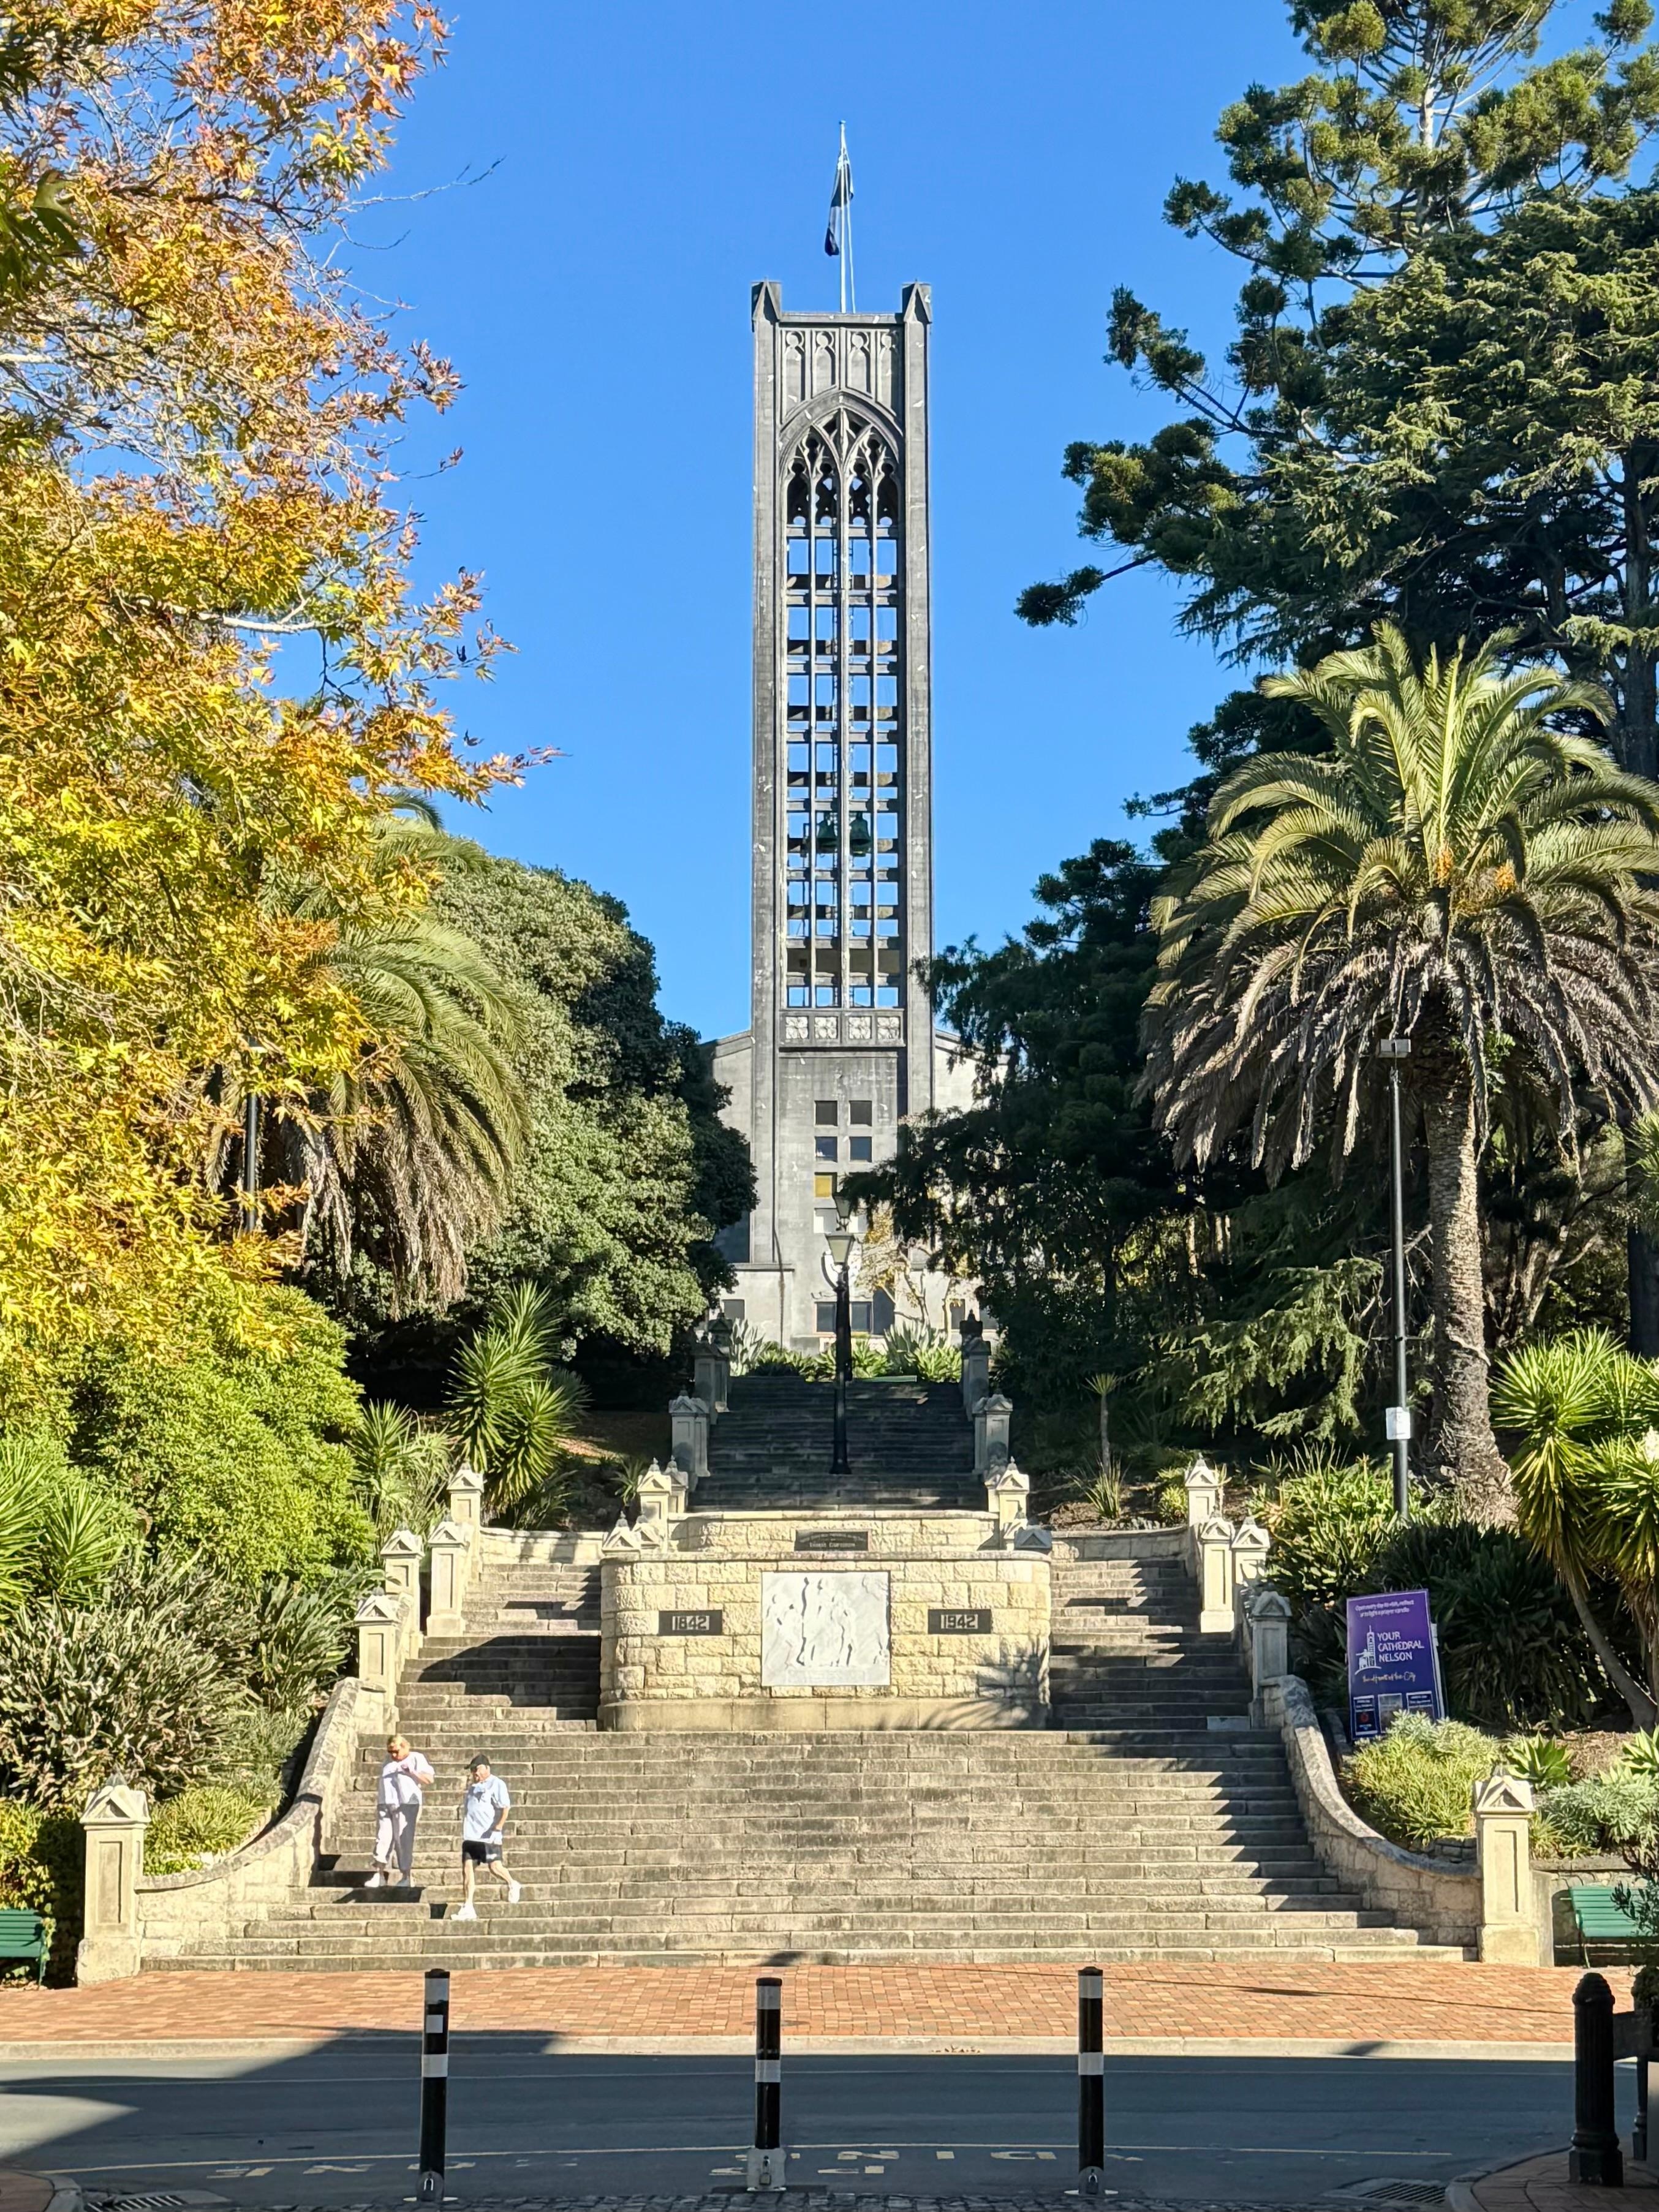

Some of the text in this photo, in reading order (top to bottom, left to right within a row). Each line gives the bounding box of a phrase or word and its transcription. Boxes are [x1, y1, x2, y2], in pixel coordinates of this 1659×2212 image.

[673, 1615, 708, 1630] 1842
[942, 1614, 977, 1629] 1942
[1377, 1631, 1401, 1642] YOUR
[1378, 1640, 1425, 1652] CATHEDRAL
[1379, 1651, 1413, 1663] NELSON
